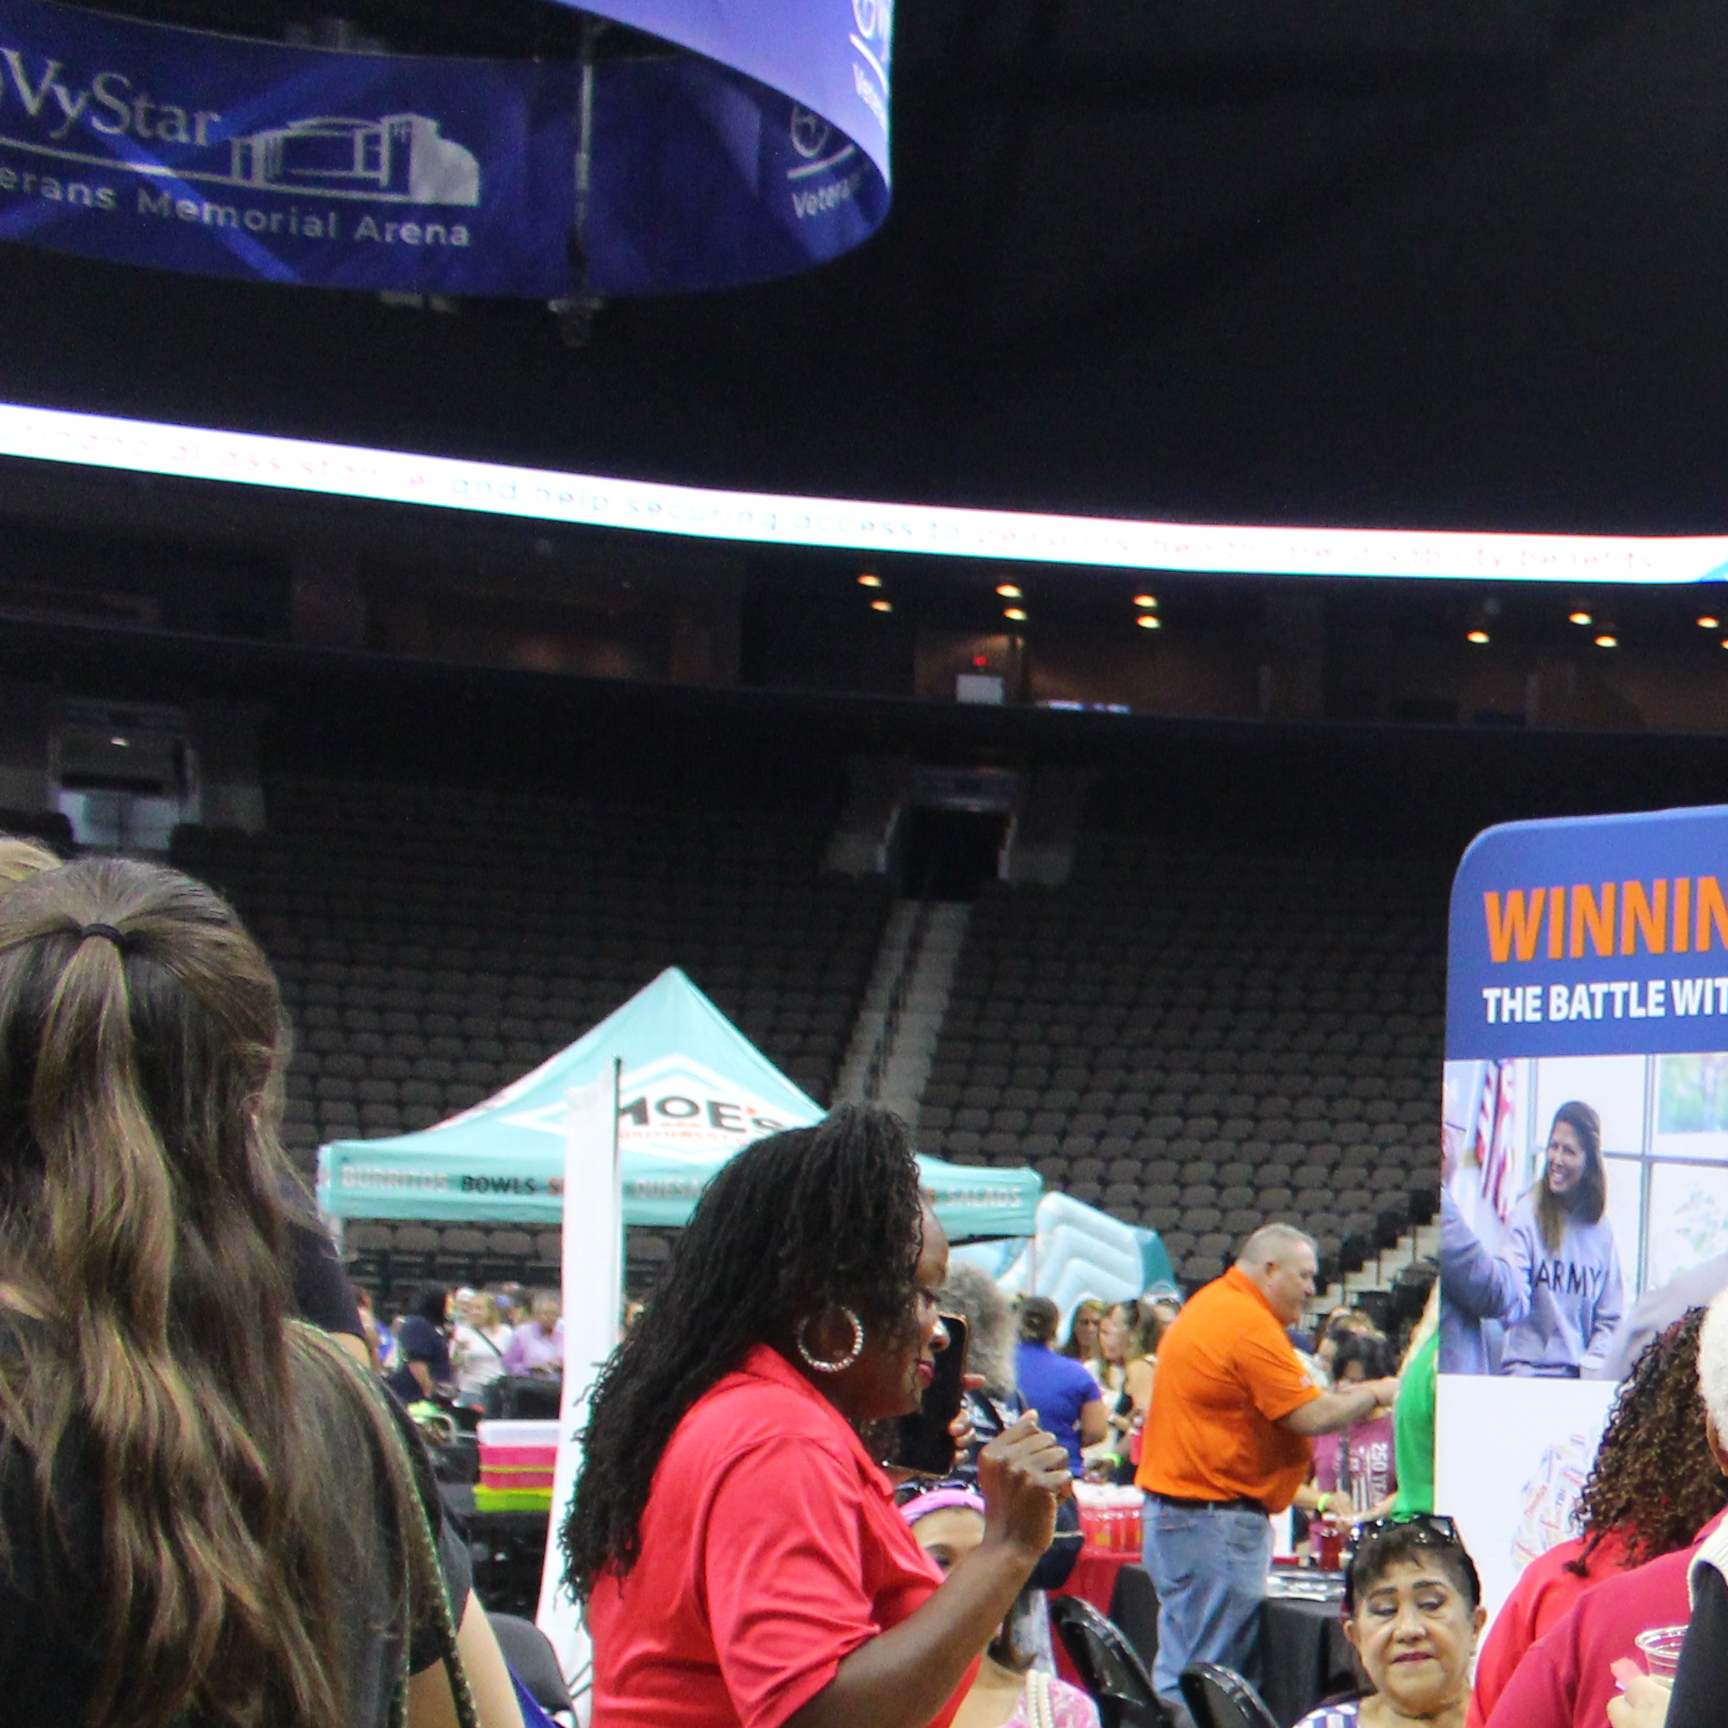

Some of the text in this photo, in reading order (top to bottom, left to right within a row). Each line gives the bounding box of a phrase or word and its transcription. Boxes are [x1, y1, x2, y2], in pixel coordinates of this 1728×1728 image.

[136, 185, 338, 240] Memorial
[353, 214, 472, 248] Arena
[1482, 984, 1542, 1024] THE
[1547, 979, 1666, 1023] BATTLE
[461, 1175, 537, 1195] BOWLS
